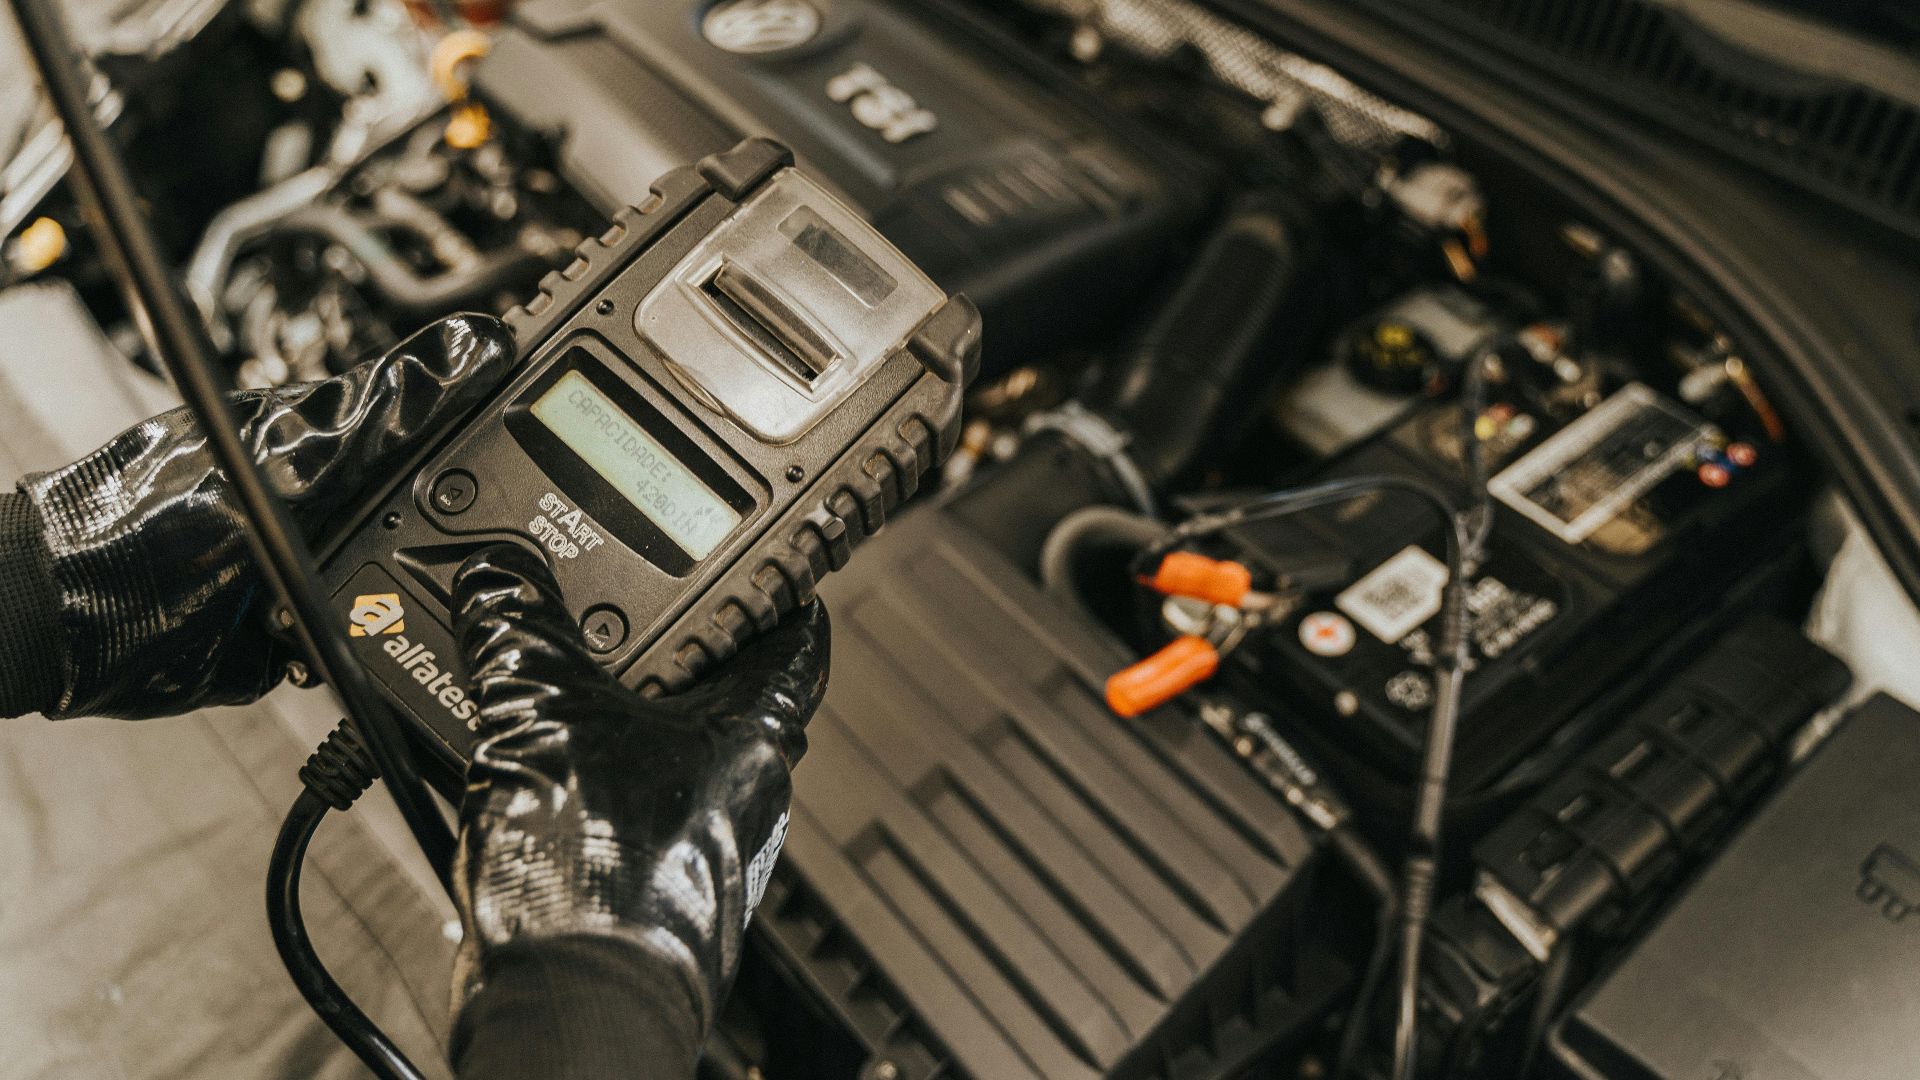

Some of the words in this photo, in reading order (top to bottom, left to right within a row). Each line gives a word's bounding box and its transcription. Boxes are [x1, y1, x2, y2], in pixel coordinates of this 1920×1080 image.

[568, 389, 672, 483] CAPACIDADE:
[528, 515, 579, 559] STOP
[539, 493, 604, 550] START
